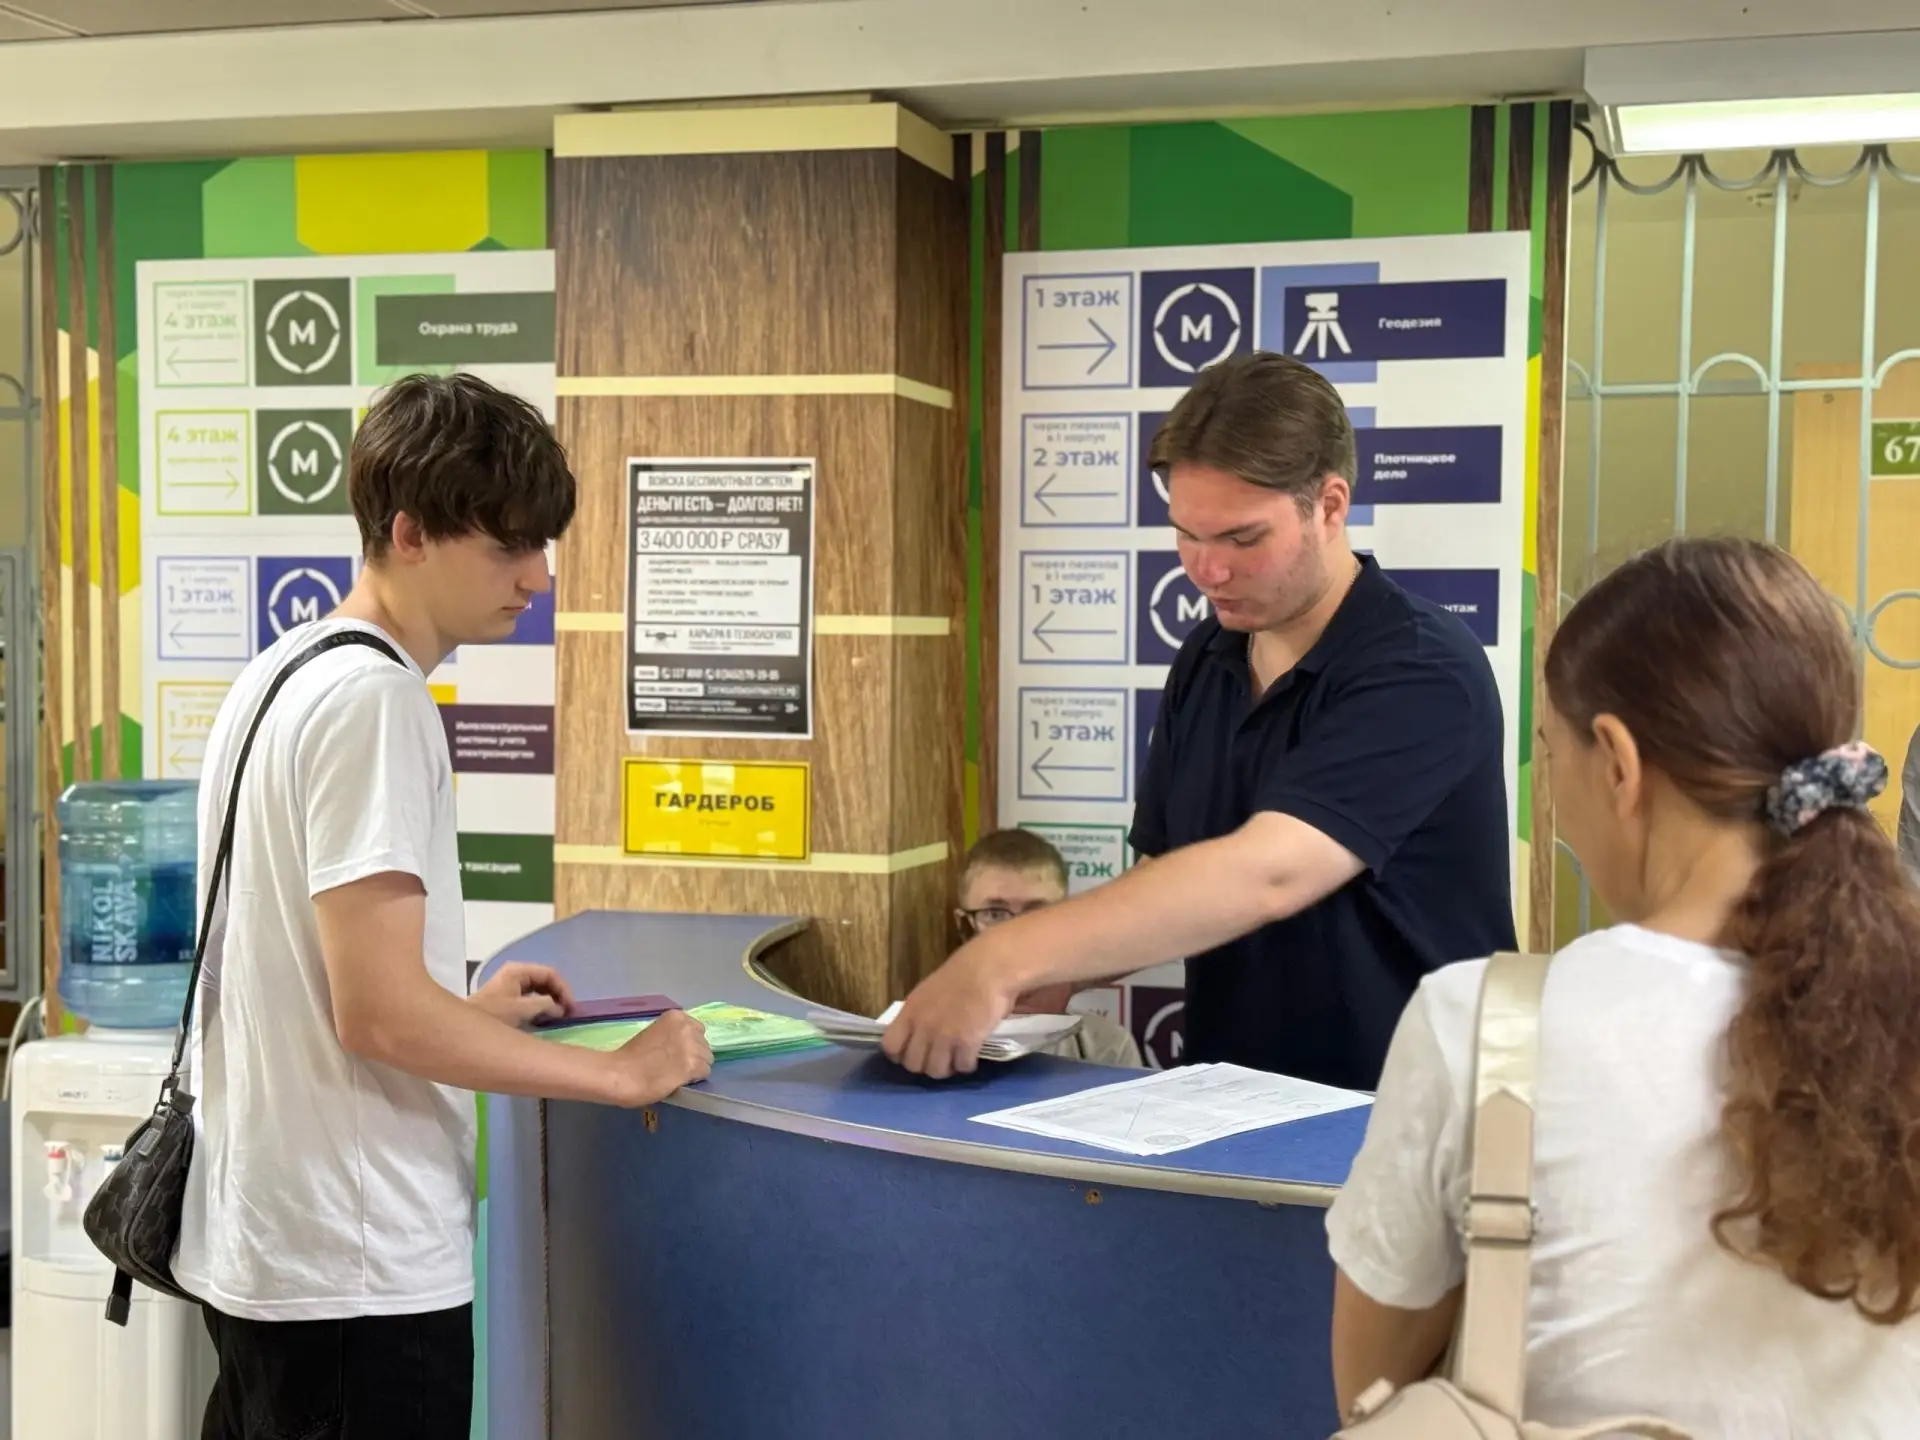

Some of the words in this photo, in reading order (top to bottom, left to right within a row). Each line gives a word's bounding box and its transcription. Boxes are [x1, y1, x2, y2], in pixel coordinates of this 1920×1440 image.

[1035, 288, 1044, 308] 1
[1053, 289, 1120, 308] этаж
[184, 313, 238, 329] этаж
[418, 321, 473, 338] Охрана
[476, 321, 518, 337] труда
[1378, 317, 1442, 331] Геодезия
[186, 428, 239, 444] этаж
[1032, 447, 1048, 467] 2
[1055, 449, 1119, 467] этаж
[1373, 452, 1456, 465] Плотницкое
[1373, 469, 1408, 481] дело
[637, 495, 683, 513] ДЕНЬГИ
[685, 496, 714, 512] ЕСТЬ
[727, 496, 774, 514] ДОЛГОВ
[776, 497, 804, 512] НЕТ!
[640, 530, 650, 549] 3
[653, 530, 683, 549] 400
[687, 530, 718, 549] 000
[737, 532, 783, 550] СРАЗУ
[168, 584, 175, 603] 1
[181, 589, 234, 603] этаж
[1032, 584, 1041, 604] 1
[1050, 588, 1117, 605] этаж
[1440, 603, 1478, 613] нтаж
[183, 714, 214, 728] эта
[1030, 720, 1039, 740] 1
[1048, 724, 1115, 742] этаж
[655, 793, 775, 812] ГАРДЕРОБ
[1066, 861, 1113, 878] таж
[92, 880, 114, 962] NIKOL
[114, 879, 138, 963] SKAYA
